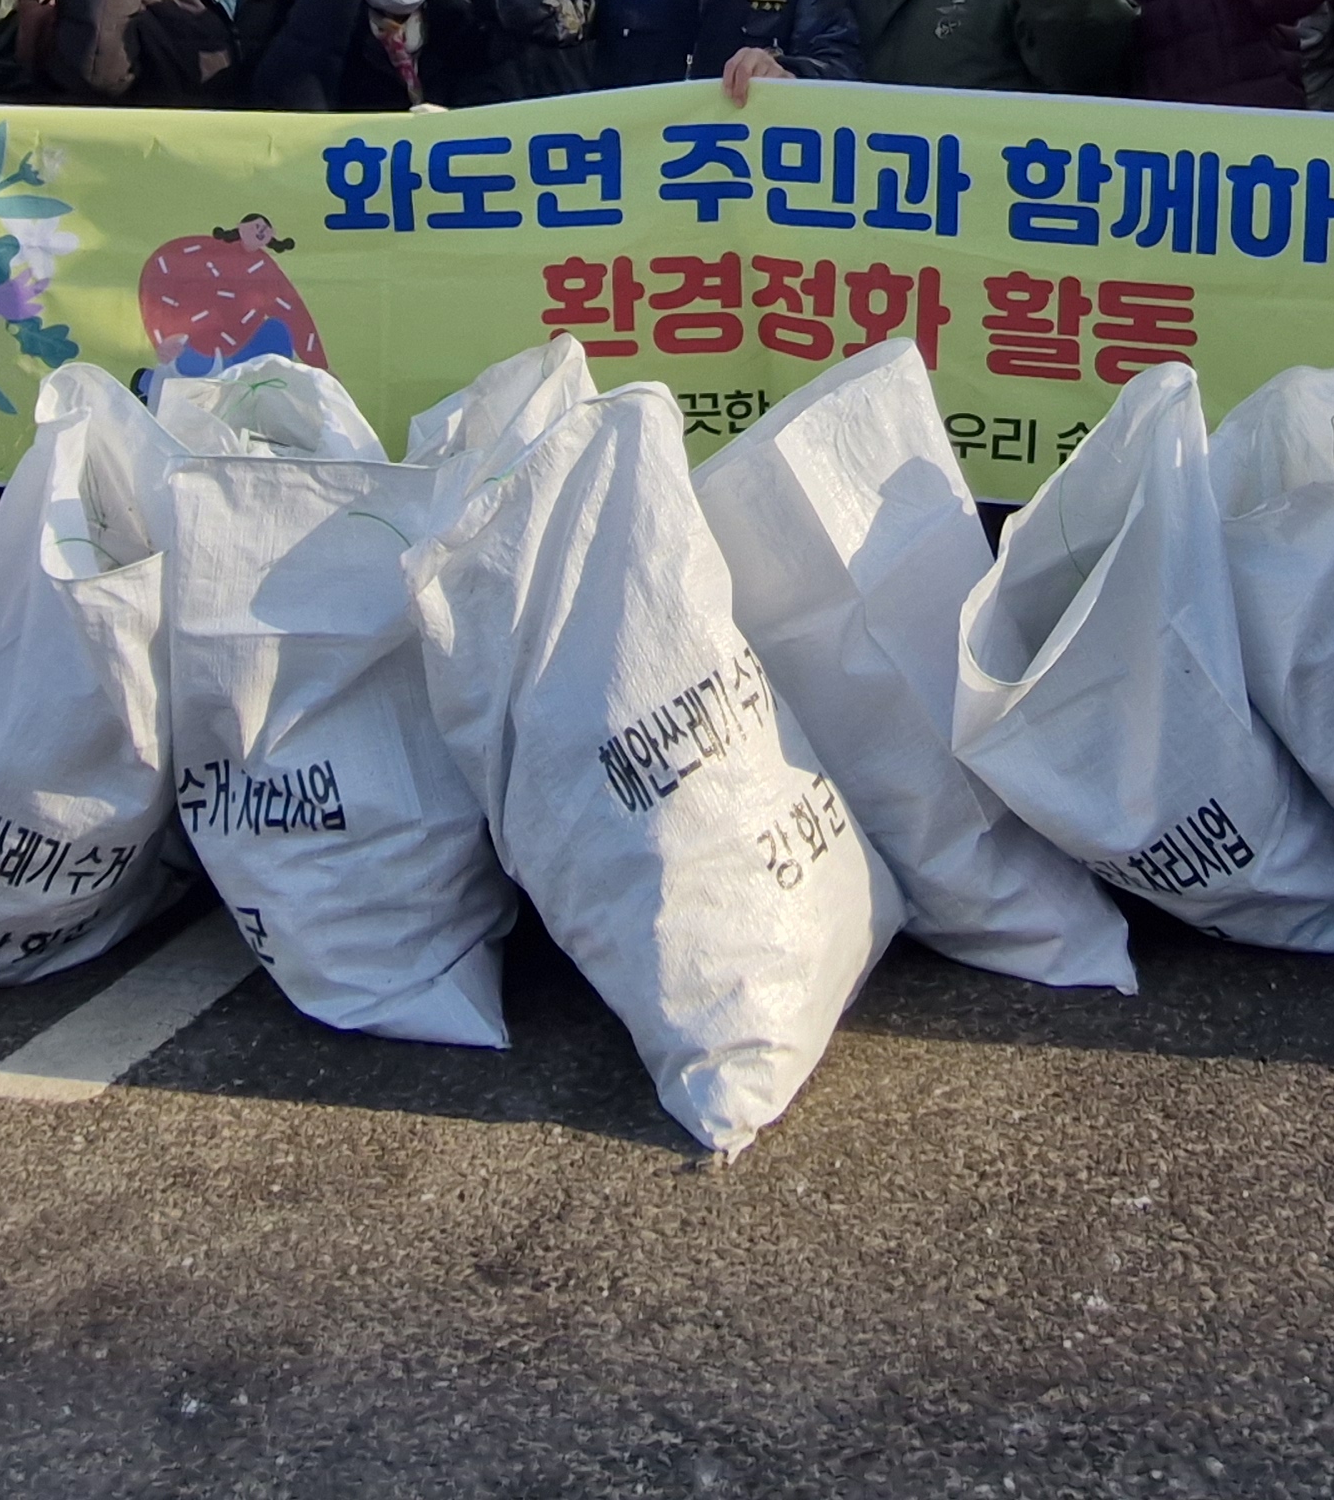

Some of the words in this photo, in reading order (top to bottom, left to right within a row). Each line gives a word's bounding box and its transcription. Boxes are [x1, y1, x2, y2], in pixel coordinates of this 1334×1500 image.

[322, 127, 624, 233] 화도면
[659, 123, 971, 237] 주민과
[541, 251, 951, 371] 환경정화
[982, 271, 1198, 385] 활동
[677, 388, 771, 436] 끗한
[943, 412, 1037, 464] 우리
[598, 669, 747, 814] 해안쓰레기
